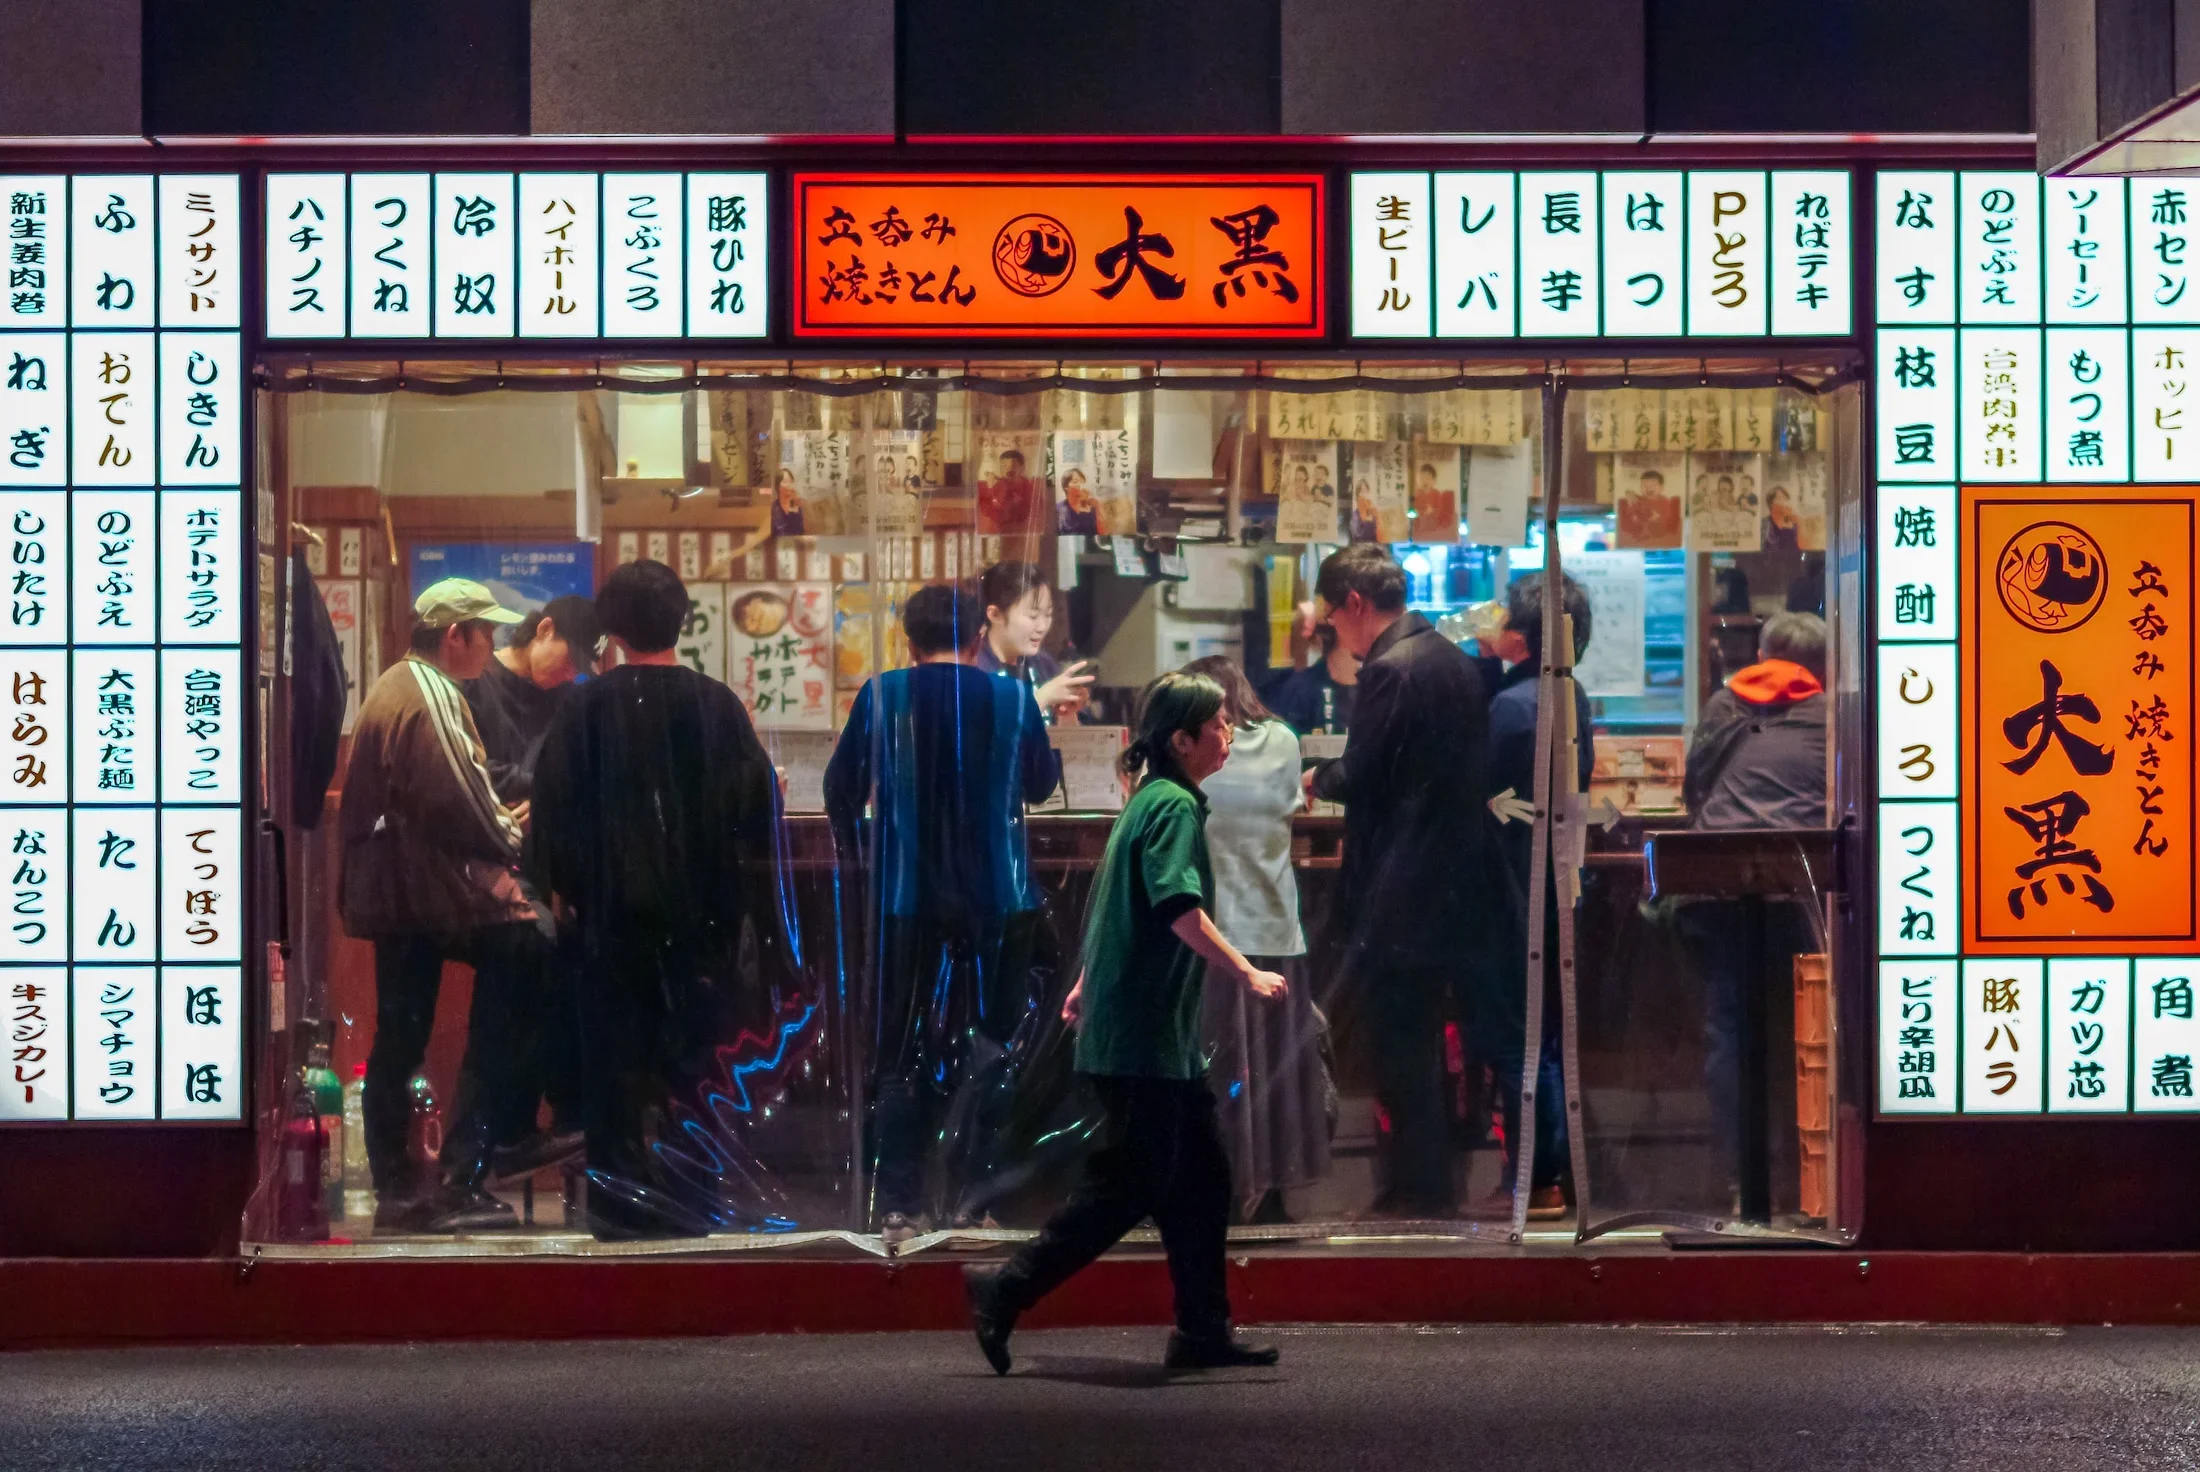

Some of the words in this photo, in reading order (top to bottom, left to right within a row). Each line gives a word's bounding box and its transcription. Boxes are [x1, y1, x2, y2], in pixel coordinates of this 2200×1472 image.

[95, 194, 136, 310] ふわ
[289, 198, 325, 312] ハチノス
[374, 197, 409, 312] つくね
[454, 196, 496, 315] 冷奴
[625, 196, 661, 311] こぶくろ
[708, 196, 747, 314] 豚ひれ
[820, 207, 955, 246] 立呑み
[822, 256, 975, 305] 焼きとん
[1096, 205, 1298, 307] 大黒
[1376, 196, 1411, 311] 生ビール
[1457, 196, 1498, 310] レバ
[1541, 192, 1582, 311] 長芋
[1625, 192, 1664, 307] はつ
[1796, 192, 1831, 309] ればテキ
[1894, 190, 1935, 307] なす
[1980, 189, 2017, 305] のどぶえ
[2152, 189, 2187, 307] 赤セン
[7, 352, 50, 469] ねぎ
[99, 352, 131, 467] おでん
[185, 351, 219, 468] しきん
[1894, 345, 1937, 465] 枝豆
[2067, 348, 2104, 467] もつ煮
[12, 510, 47, 626] しいたけ
[97, 511, 134, 627] のどぶえ
[1894, 506, 1936, 624] 焼酎
[2129, 562, 2168, 678] 立呑み
[12, 672, 47, 787] はらみ
[98, 669, 135, 790] 大黒ぶた麺
[185, 669, 221, 790] 台湾やっこ
[1898, 668, 1934, 781] しろ
[2125, 696, 2173, 856] 焼きとん
[2004, 660, 2114, 919] 大黒
[12, 829, 47, 944] なんこつ
[98, 830, 136, 948] たん
[186, 830, 221, 945] てっぽう
[1900, 826, 1935, 940] つくね
[11, 983, 48, 1104] 牛スジカレー
[100, 984, 134, 1104] シマチョウ
[186, 985, 222, 1104] ほほ
[1983, 978, 2019, 1095] 豚バラ
[2068, 979, 2106, 1098] ガツ芯
[2152, 976, 2194, 1097] 角煮
